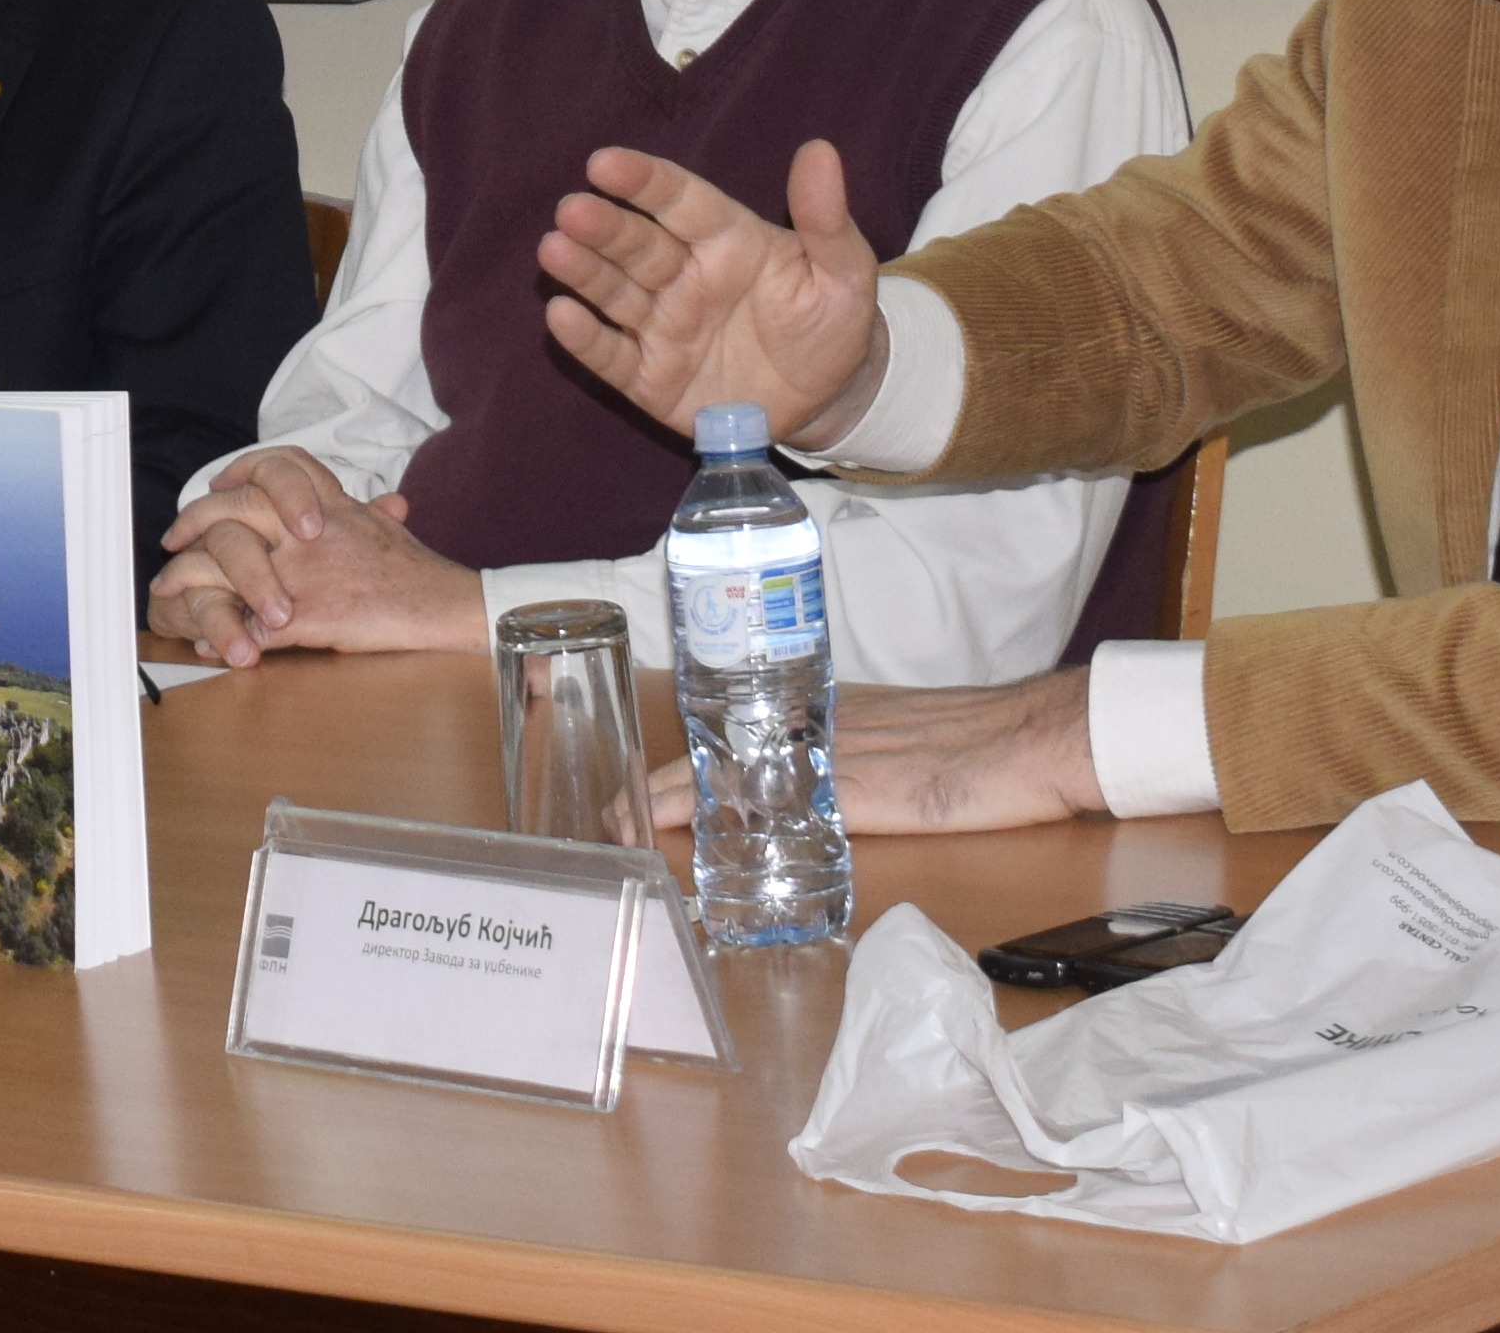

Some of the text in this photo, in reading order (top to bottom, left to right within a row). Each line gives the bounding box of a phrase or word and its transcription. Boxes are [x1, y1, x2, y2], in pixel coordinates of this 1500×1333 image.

[357, 900, 553, 951] Драгољуб Којчић
[1398, 921, 1442, 949] CENTAR
[258, 959, 287, 974] ФПН
[362, 941, 542, 979] директор Завода за уџбенике
[1444, 948, 1470, 963] CALL
